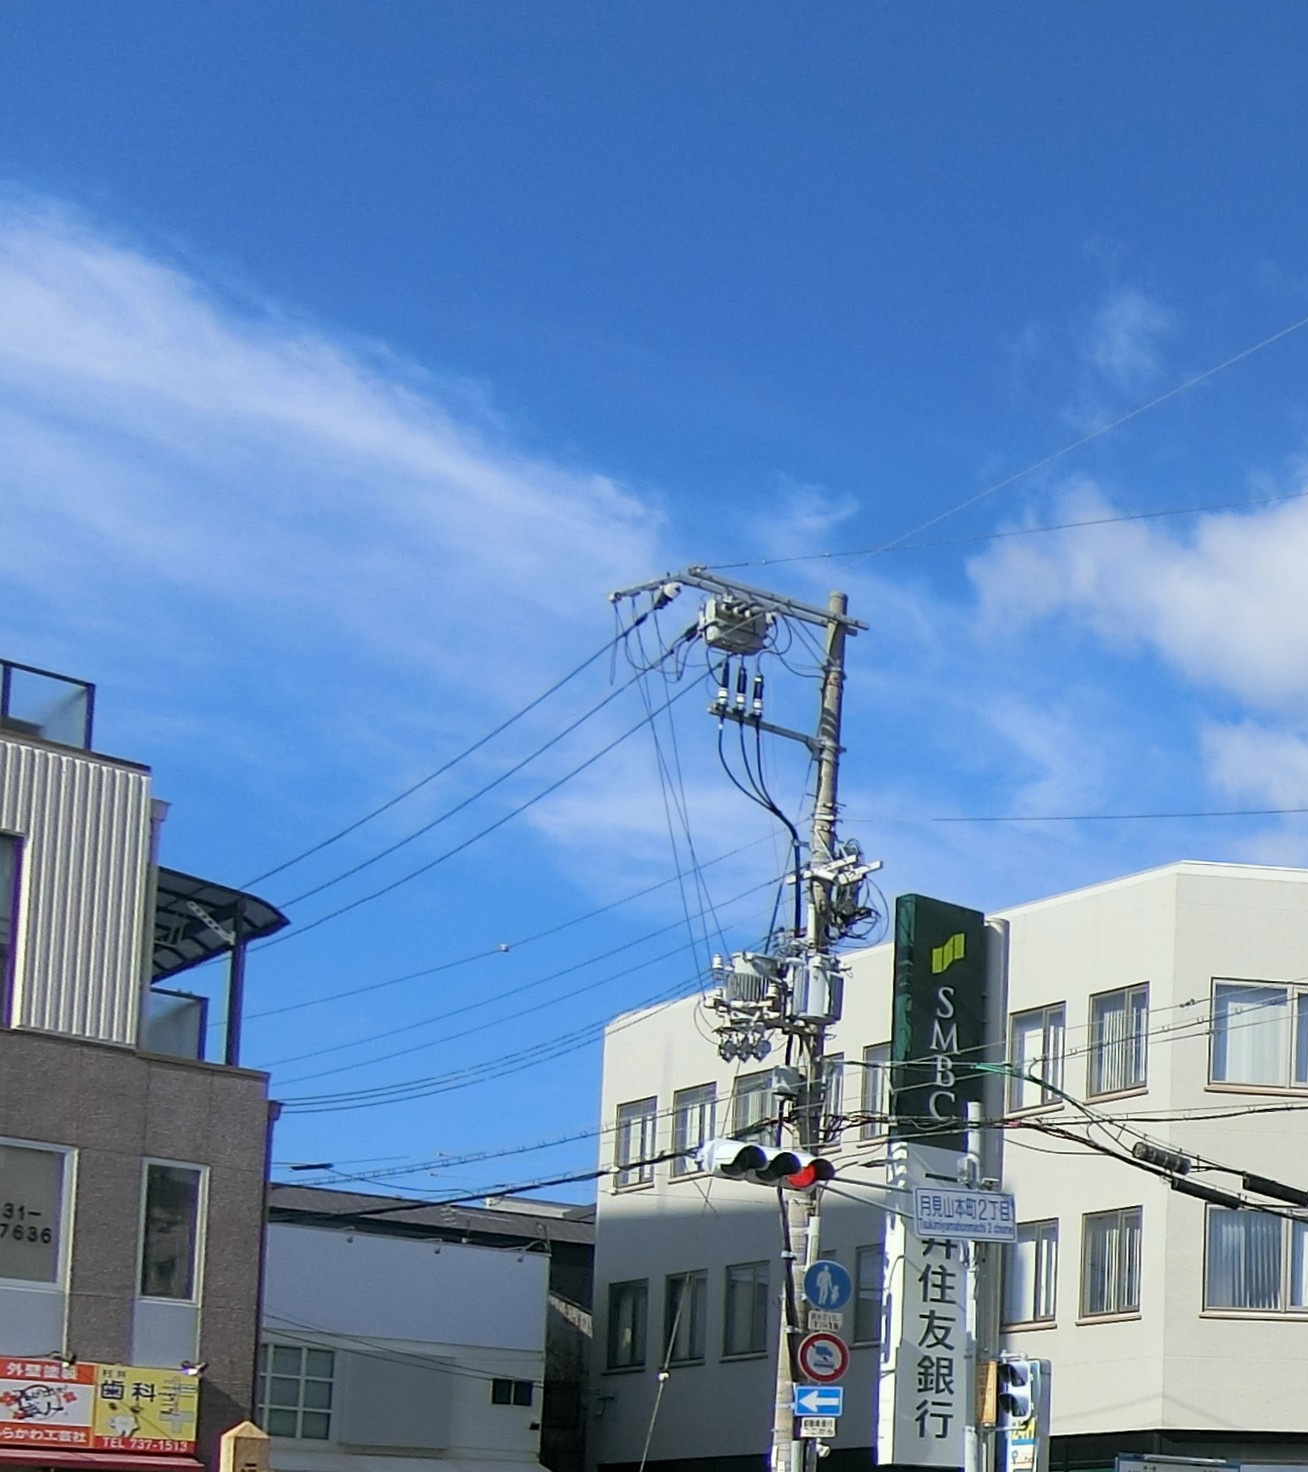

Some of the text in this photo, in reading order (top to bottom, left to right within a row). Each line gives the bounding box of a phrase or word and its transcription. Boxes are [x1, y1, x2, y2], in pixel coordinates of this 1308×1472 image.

[929, 986, 961, 1122] SMBC
[920, 1195, 1011, 1222] 月見山本町2丁目
[0, 1222, 52, 1244] 7636
[987, 1222, 993, 1233] 2
[101, 1380, 156, 1403] 歯科
[0, 1426, 87, 1443] らかわ工芸社
[102, 1436, 188, 1452] TEL 737-1513
